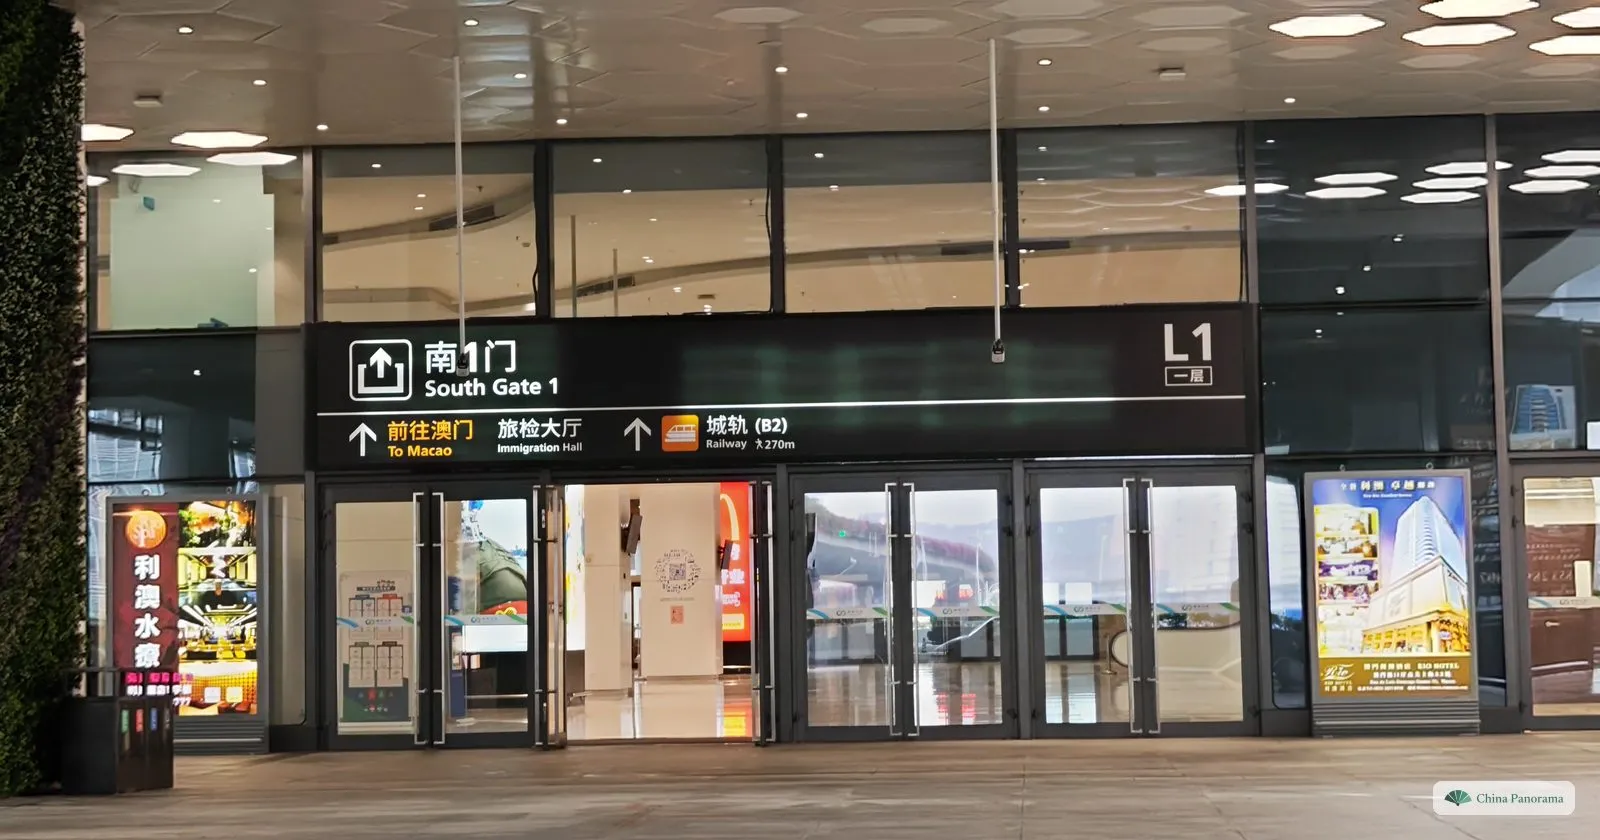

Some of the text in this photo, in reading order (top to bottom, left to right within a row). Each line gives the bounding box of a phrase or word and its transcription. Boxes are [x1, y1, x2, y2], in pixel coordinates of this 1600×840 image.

[1164, 322, 1212, 362] L1
[424, 339, 517, 374] 南1门
[1173, 368, 1204, 383] 一层
[424, 377, 558, 397] South Gate 1
[387, 419, 474, 442] 前往澳门
[497, 417, 583, 440] 旅检大厅
[706, 414, 788, 436] 城轨 (B2)
[387, 445, 453, 457] To Macao
[497, 442, 583, 455] Immigration Hall
[706, 439, 796, 450] Railway 270m
